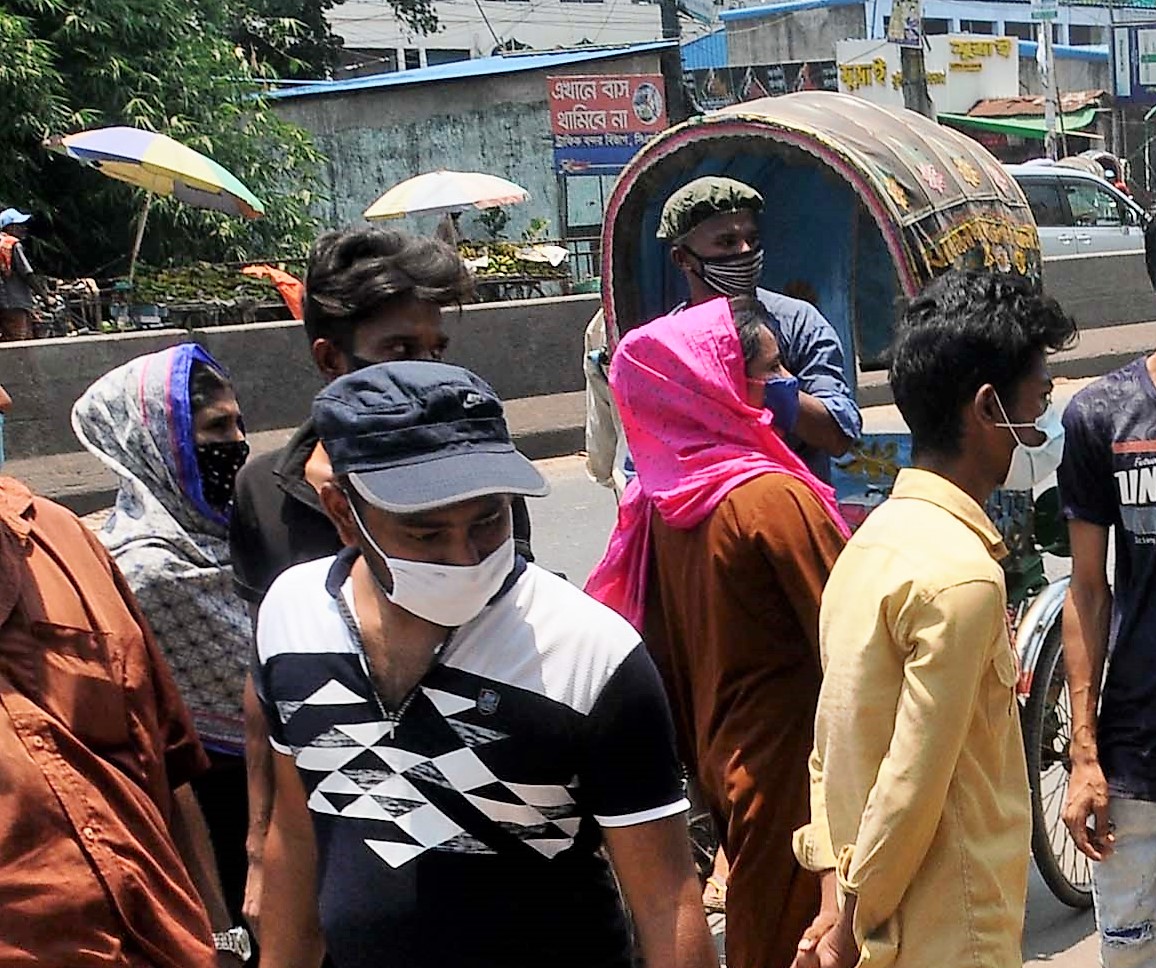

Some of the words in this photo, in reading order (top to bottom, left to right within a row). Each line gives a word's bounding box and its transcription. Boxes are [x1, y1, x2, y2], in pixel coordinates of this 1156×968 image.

[551, 80, 597, 101] এখানে
[600, 80, 630, 99] বাস
[557, 103, 607, 130] থামিবে
[609, 109, 629, 129] না
